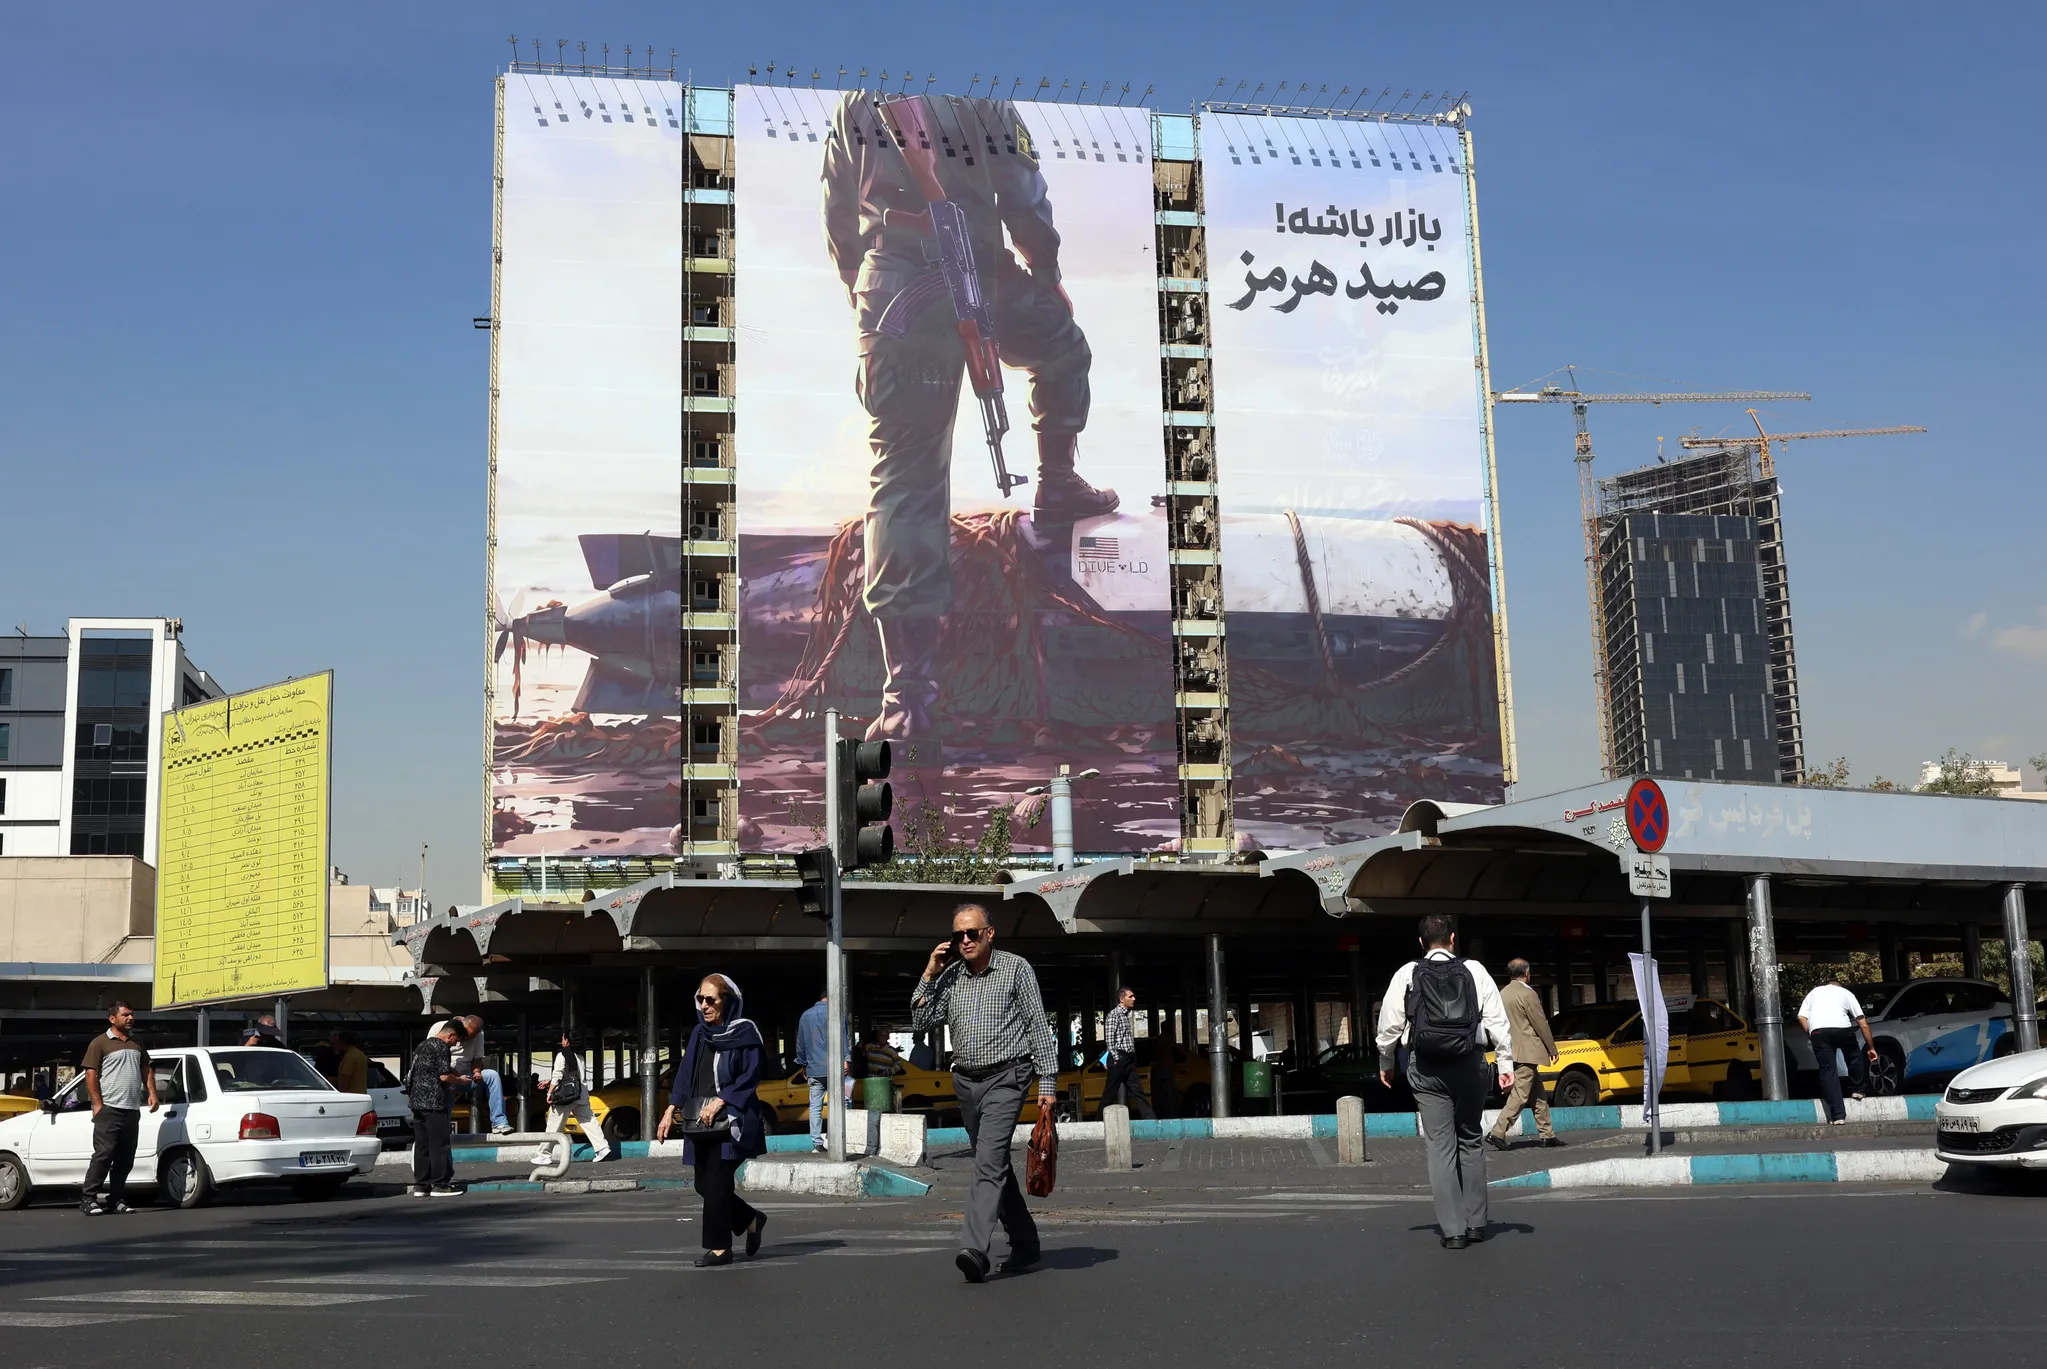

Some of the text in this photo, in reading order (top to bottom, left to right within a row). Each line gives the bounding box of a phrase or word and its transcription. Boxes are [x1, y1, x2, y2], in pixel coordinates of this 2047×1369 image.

[1276, 203, 1442, 251] بازار باشه!
[1224, 250, 1446, 315] صید هرمز
[282, 688, 306, 699] معاونت
[266, 694, 280, 705] حمل
[229, 701, 249, 712] ترافیک
[275, 707, 293, 717] سازمان
[285, 741, 316, 755] شماره خط
[236, 756, 254, 766] مقصد
[198, 766, 211, 776] طول
[1563, 800, 1597, 823] کرج
